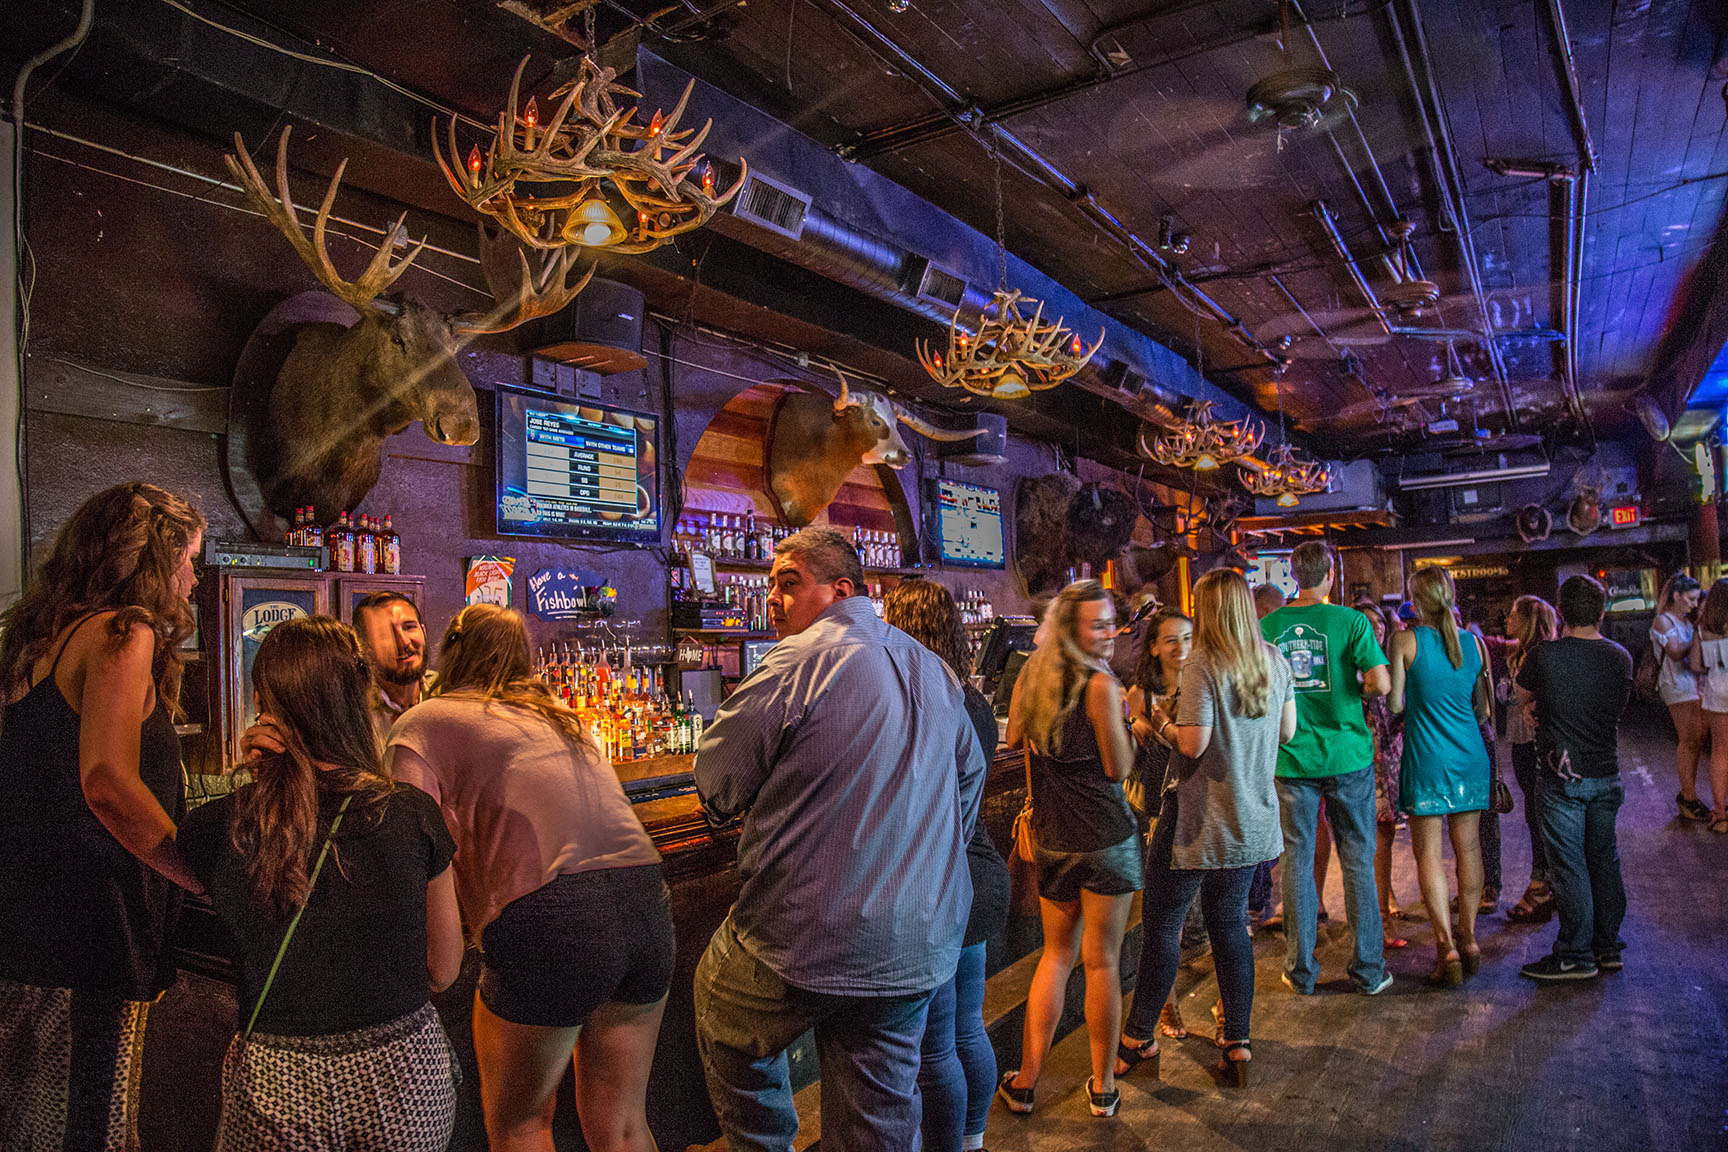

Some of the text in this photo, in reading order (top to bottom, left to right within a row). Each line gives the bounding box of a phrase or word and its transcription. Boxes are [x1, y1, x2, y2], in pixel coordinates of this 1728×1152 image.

[573, 451, 595, 460] AVERAGE
[1614, 508, 1636, 524] EXIT
[528, 571, 566, 593] Have a
[535, 586, 587, 612] Fishbowl
[254, 608, 296, 626] LODGE
